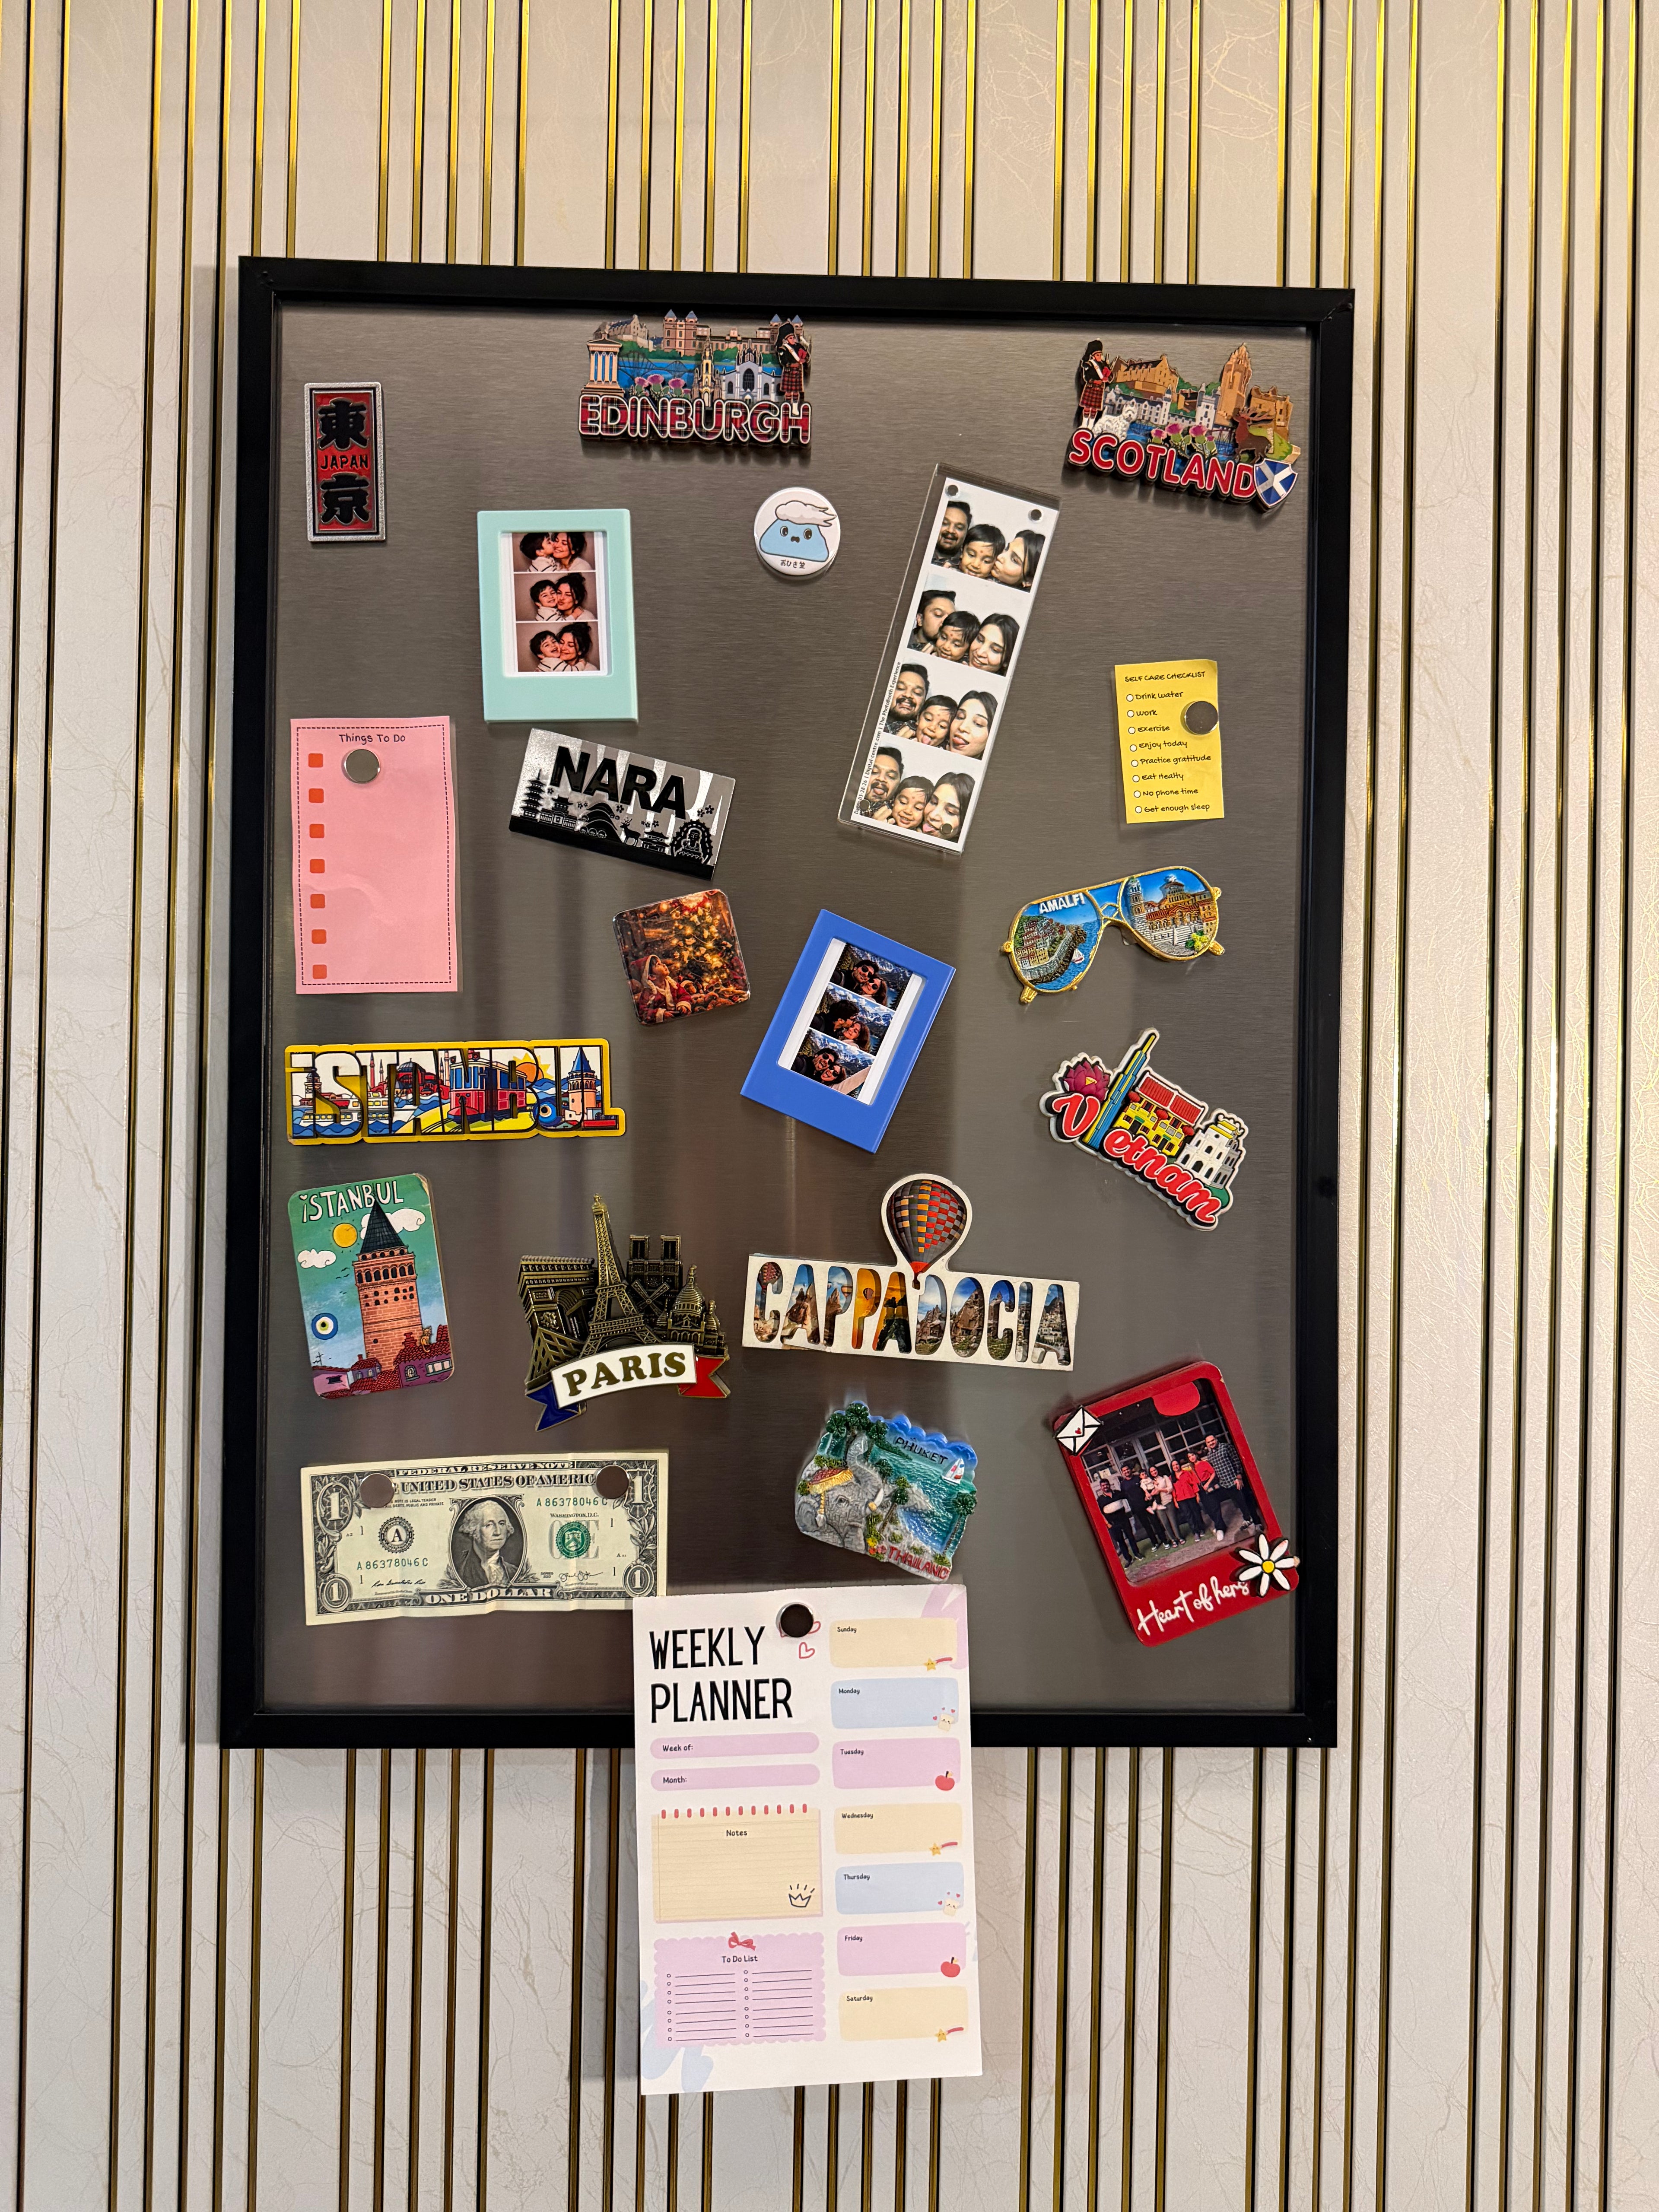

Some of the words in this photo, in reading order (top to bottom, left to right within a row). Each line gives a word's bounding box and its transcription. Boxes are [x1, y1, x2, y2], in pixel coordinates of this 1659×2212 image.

[318, 398, 369, 451] 東
[579, 394, 811, 444] EDINBURGH
[320, 455, 369, 469] JAPAN
[1069, 429, 1256, 498] SCOTLAND
[320, 473, 369, 524] 京
[1166, 671, 1205, 680] CHECKLIST
[339, 733, 373, 745] Things
[858, 780, 868, 800] 03-28-26
[865, 731, 881, 775] Digital-centre.com
[883, 689, 893, 715] PhotoBooth
[890, 661, 901, 688] Experience
[1139, 741, 1162, 750] Enjoy
[1140, 756, 1171, 765] Practice
[1173, 754, 1212, 765] gratitude
[550, 746, 686, 820] NARA
[1156, 790, 1179, 798] phone
[1191, 804, 1210, 812] sleep
[1039, 892, 1085, 914] AMALFI
[753, 1261, 1071, 1366] CAPPADOCIA
[562, 1352, 686, 1397] PARIS
[895, 1437, 948, 1465] PHUKET
[398, 1466, 467, 1476] FEDERAL
[467, 1463, 534, 1472] RESERVE
[401, 1479, 458, 1494] UNITED
[458, 1474, 514, 1491] STATES
[515, 1474, 536, 1488] OF
[536, 1473, 597, 1487] AMERIC
[391, 1529, 404, 1542] A
[888, 1545, 950, 1580] THAILAND
[426, 1593, 467, 1604] ONE
[470, 1588, 552, 1601] DOLLAR
[1137, 1600, 1195, 1636] Heart
[1193, 1583, 1214, 1611] of
[1210, 1576, 1249, 1605] hers
[649, 1626, 765, 1669] WEEKLY
[651, 1678, 793, 1723] PLANNER
